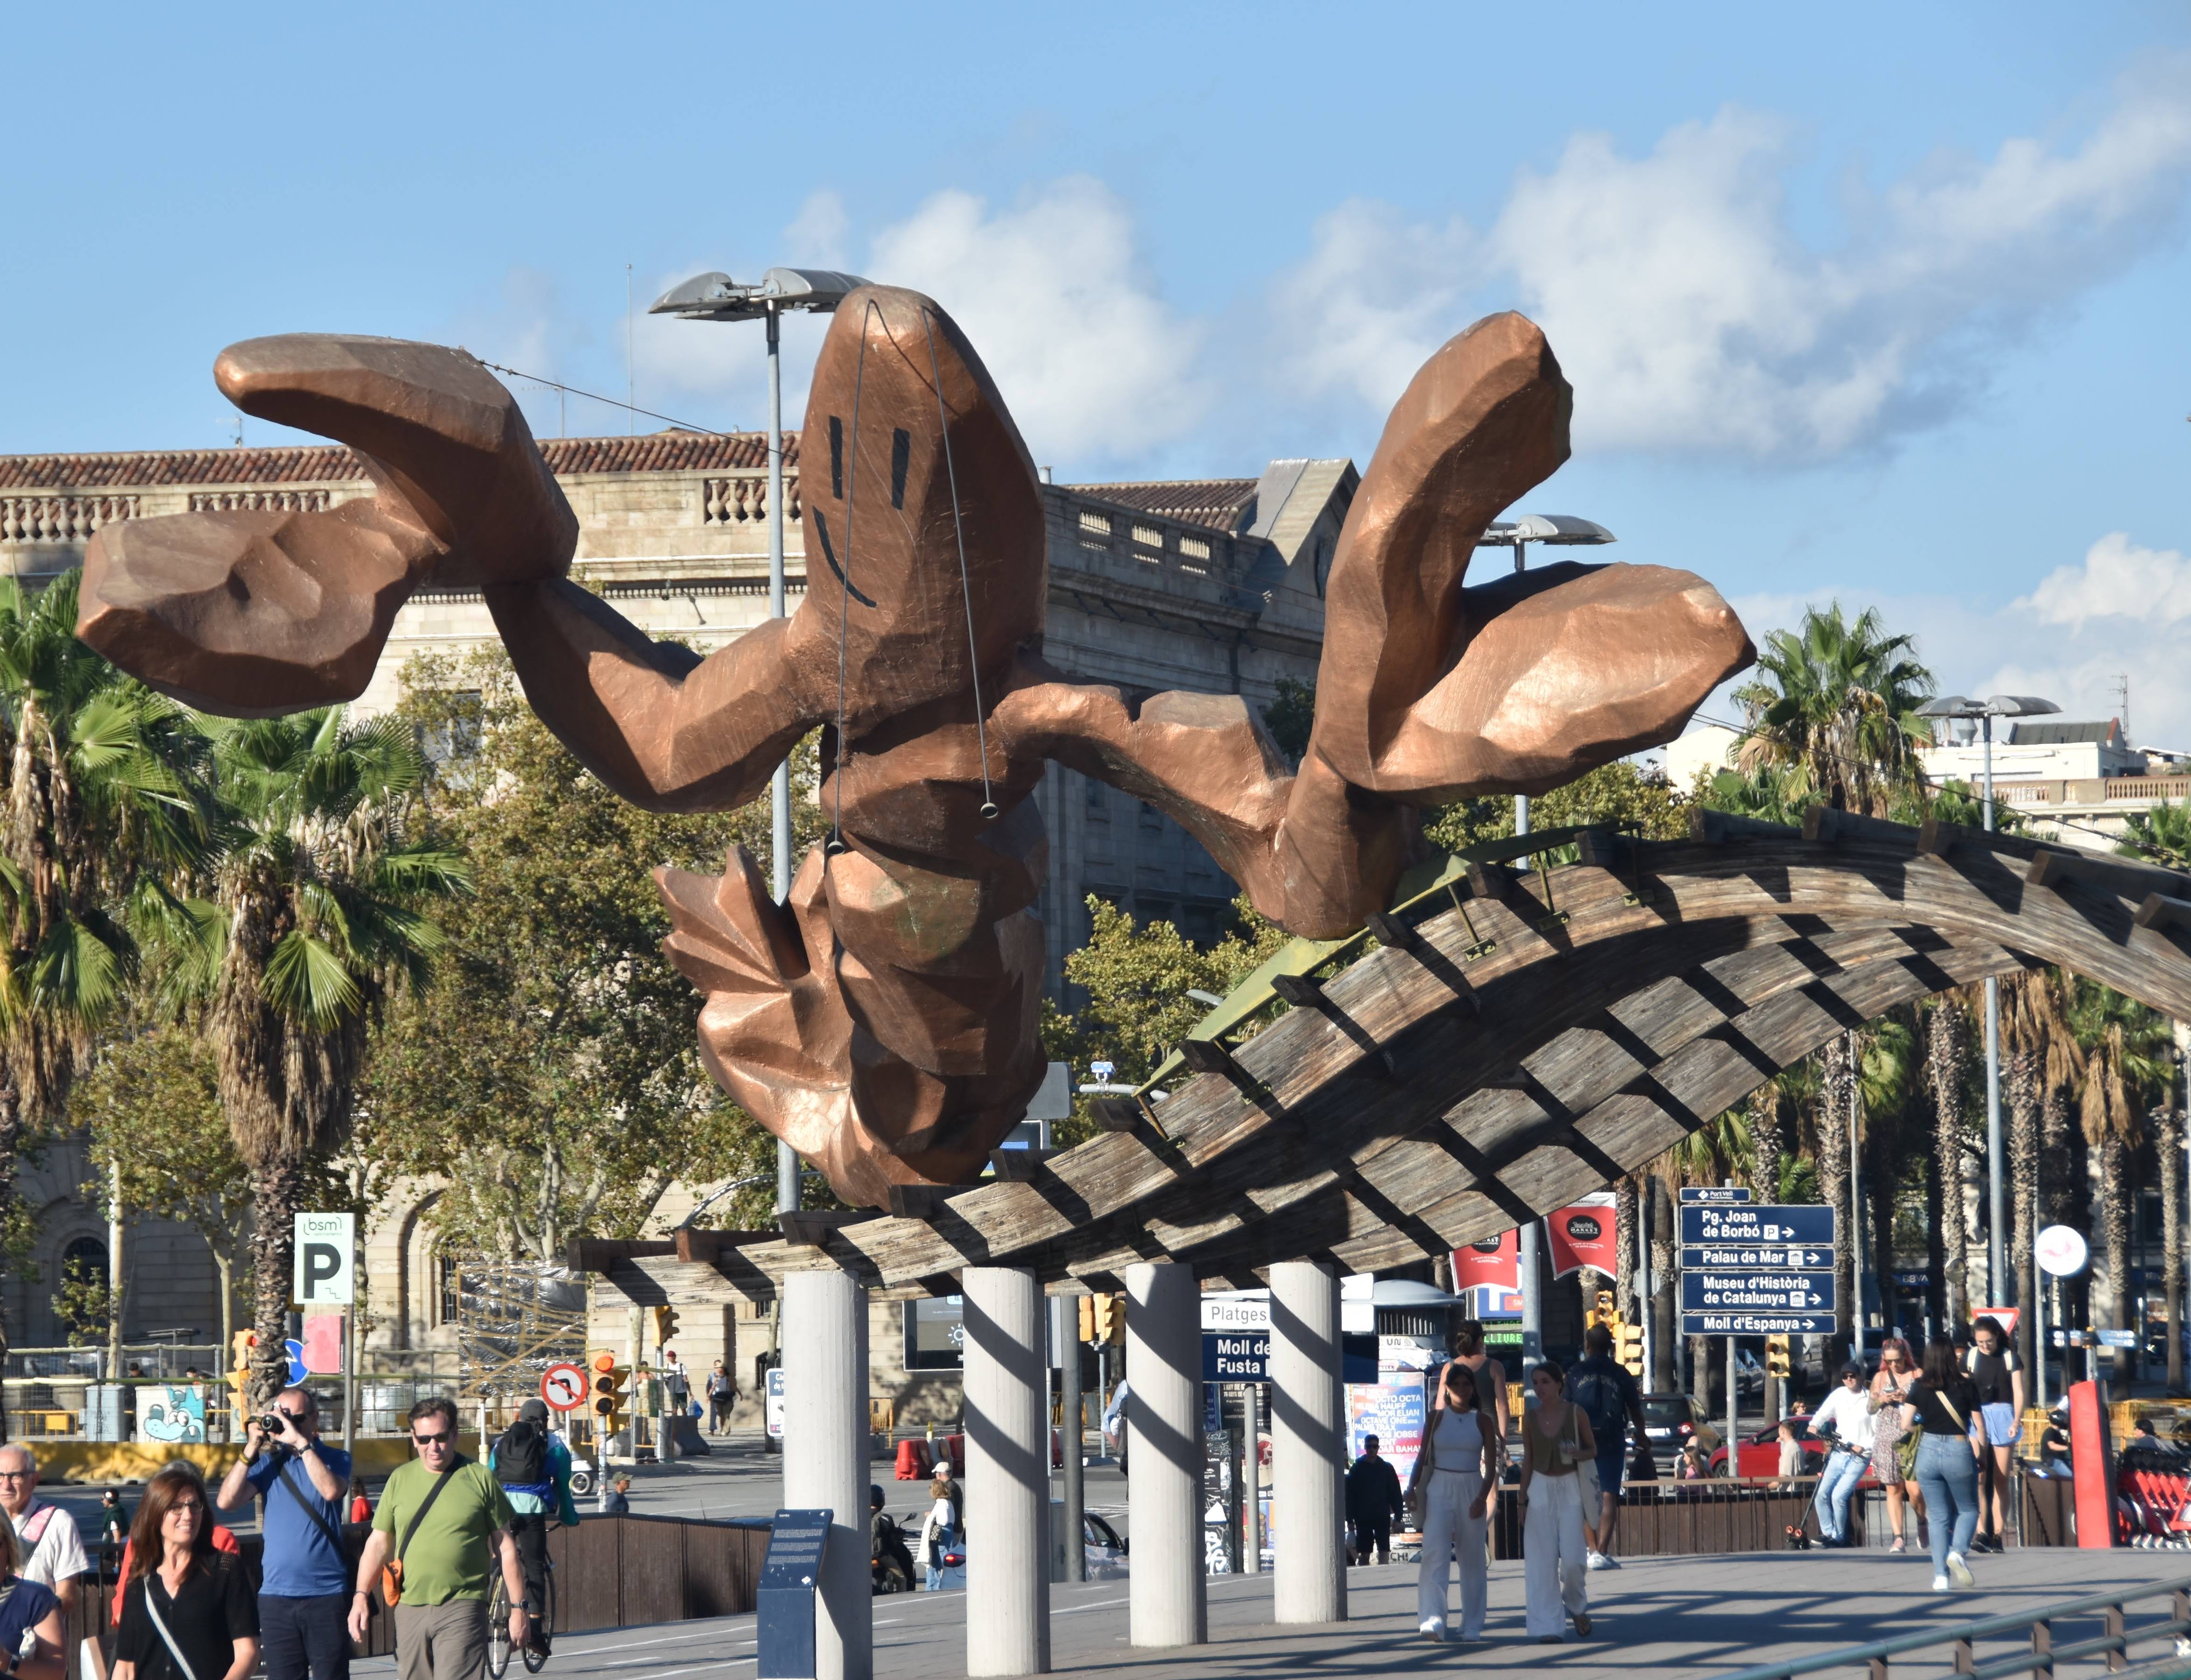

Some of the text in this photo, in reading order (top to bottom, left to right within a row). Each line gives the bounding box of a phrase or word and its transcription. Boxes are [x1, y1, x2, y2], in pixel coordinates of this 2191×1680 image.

[309, 1218, 336, 1230] bsm
[1702, 1210, 1756, 1225] Pg. Joan
[1703, 1225, 1718, 1237] de
[1721, 1224, 1760, 1237] Borbó
[1702, 1251, 1784, 1263] Palau de Mar
[303, 1243, 342, 1299] P
[1703, 1275, 1810, 1289] Museu d'Història
[1704, 1291, 1786, 1306] de Catalunya
[1211, 1306, 1266, 1324] Platges
[1704, 1316, 1799, 1332] Moll d'Espanya
[1217, 1338, 1271, 1355] Moll de
[1217, 1358, 1260, 1374] Fusta
[1393, 1429, 1418, 1438] JOBSE
